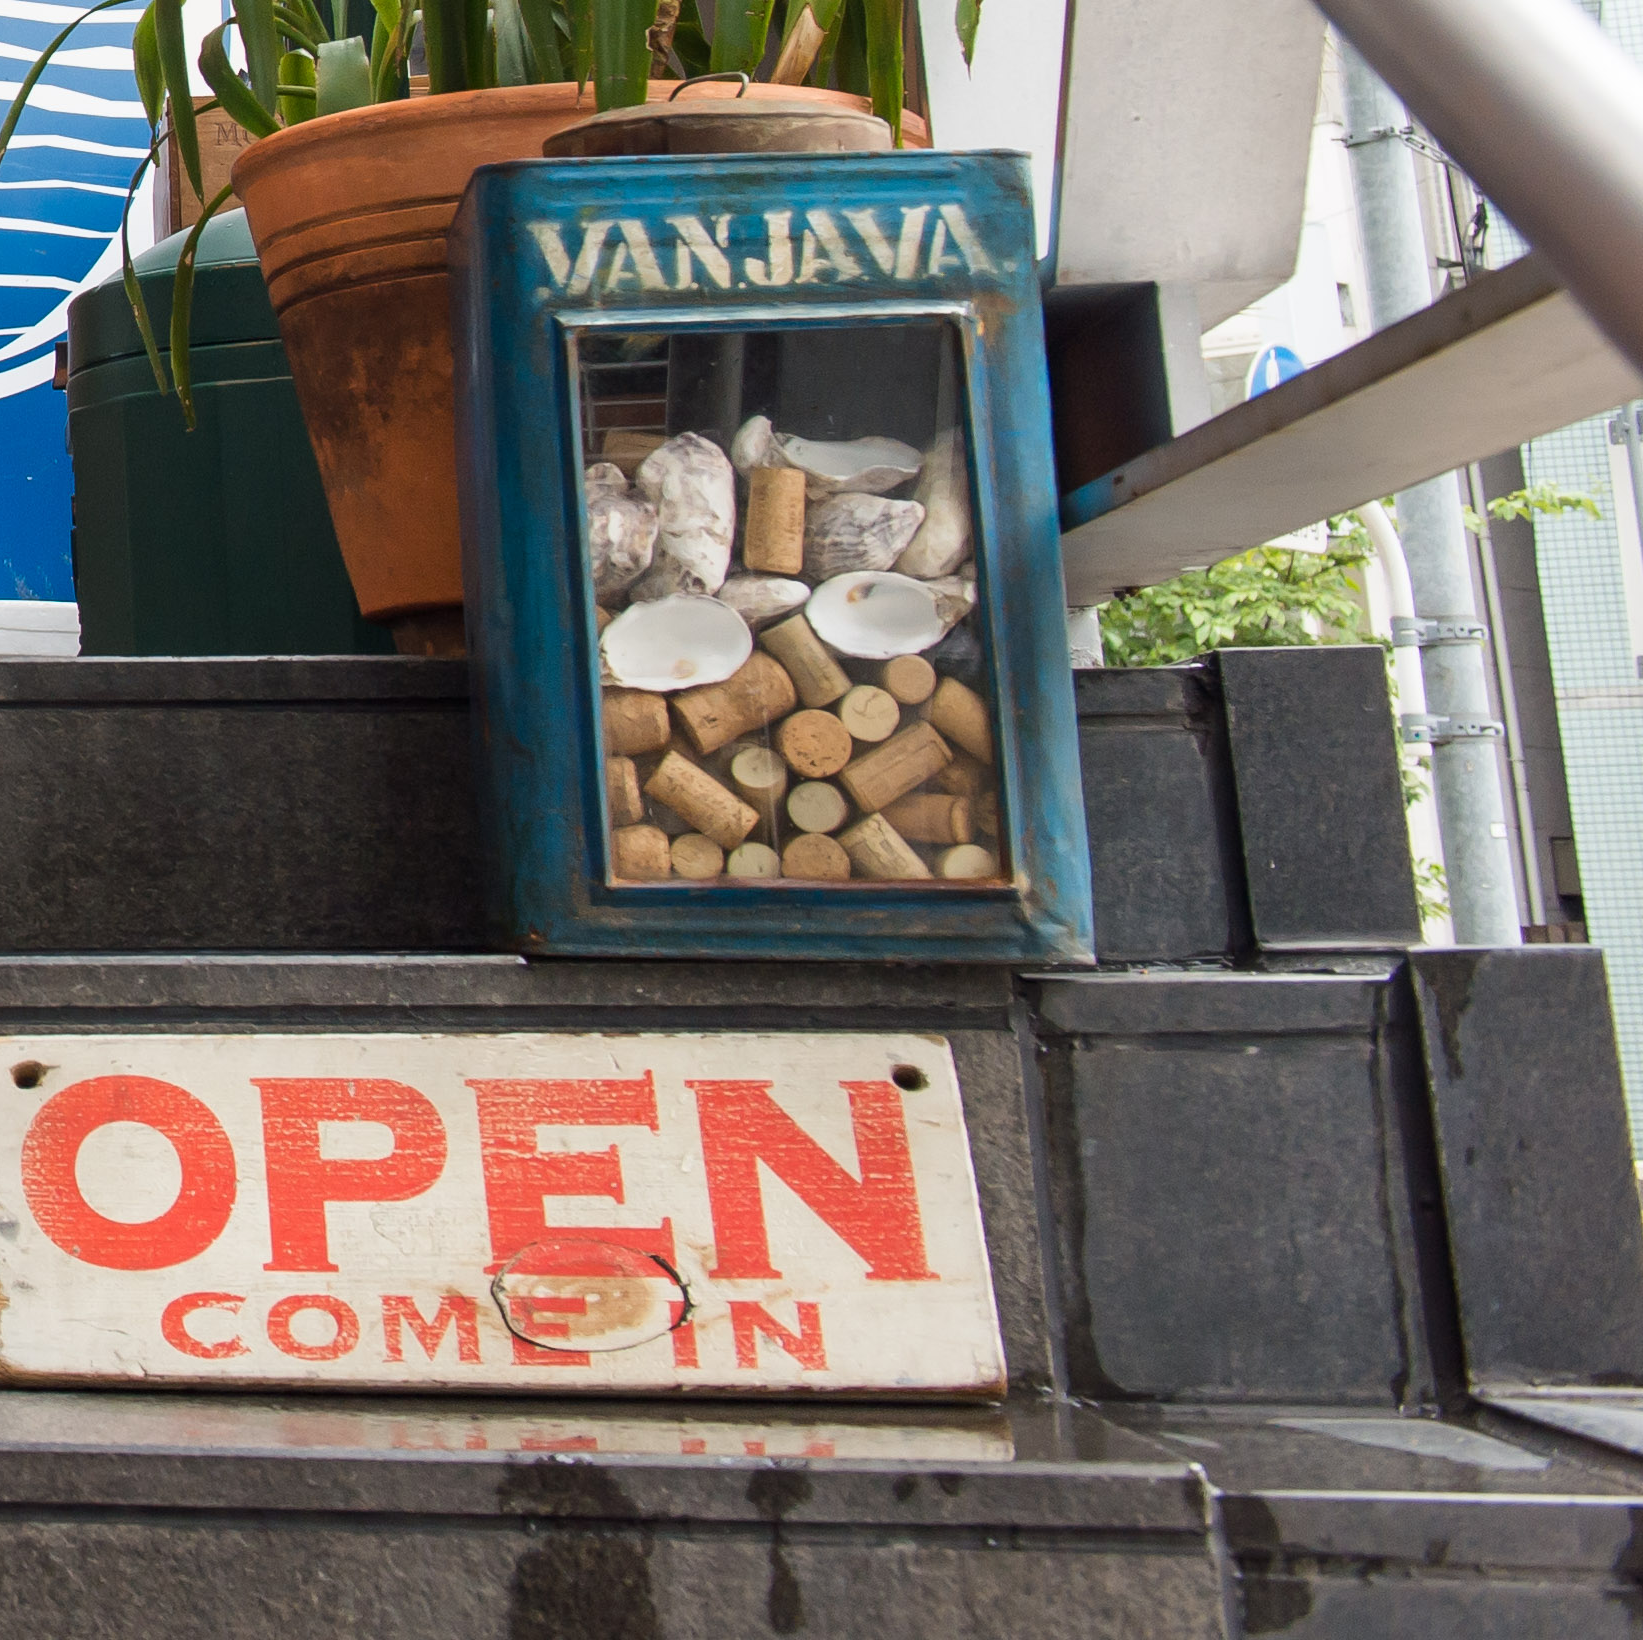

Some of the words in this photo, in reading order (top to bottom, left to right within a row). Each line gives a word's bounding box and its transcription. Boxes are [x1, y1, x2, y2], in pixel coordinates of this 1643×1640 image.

[21, 1069, 942, 1280] OPEN
[160, 1291, 593, 1367] COME
[669, 1298, 831, 1371] IN
